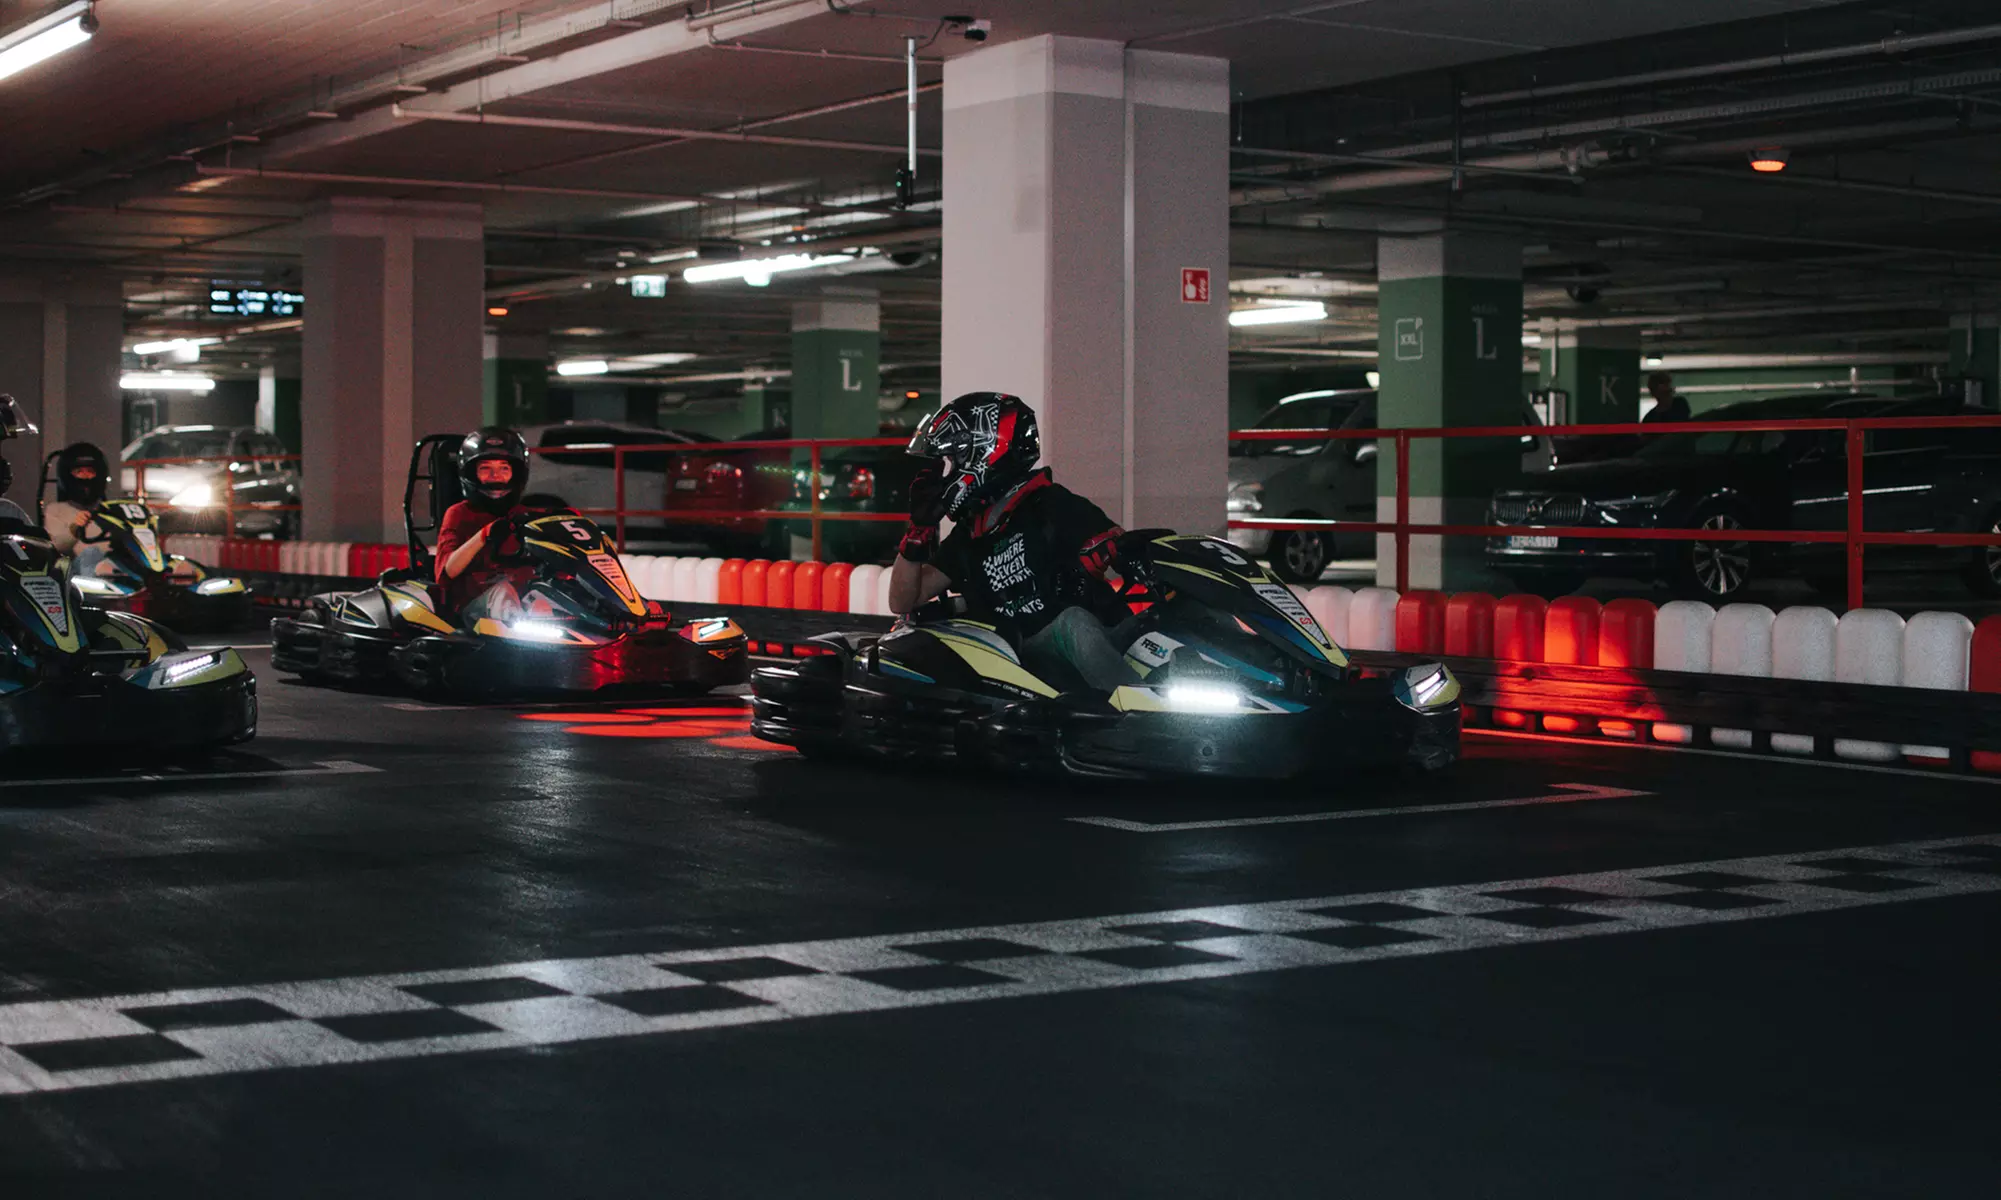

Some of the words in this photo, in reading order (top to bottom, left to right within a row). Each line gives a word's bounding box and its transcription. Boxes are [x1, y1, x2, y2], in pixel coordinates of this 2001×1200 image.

[1472, 317, 1497, 359] L
[838, 358, 862, 391] L
[1599, 376, 1620, 405] K
[119, 504, 146, 519] 19
[560, 521, 592, 540] 5
[993, 539, 1025, 567] WHERE
[1200, 541, 1248, 565] 3
[997, 553, 1026, 580] EVERY
[1003, 567, 1036, 587] TENTH
[1141, 638, 1168, 657] RSX
